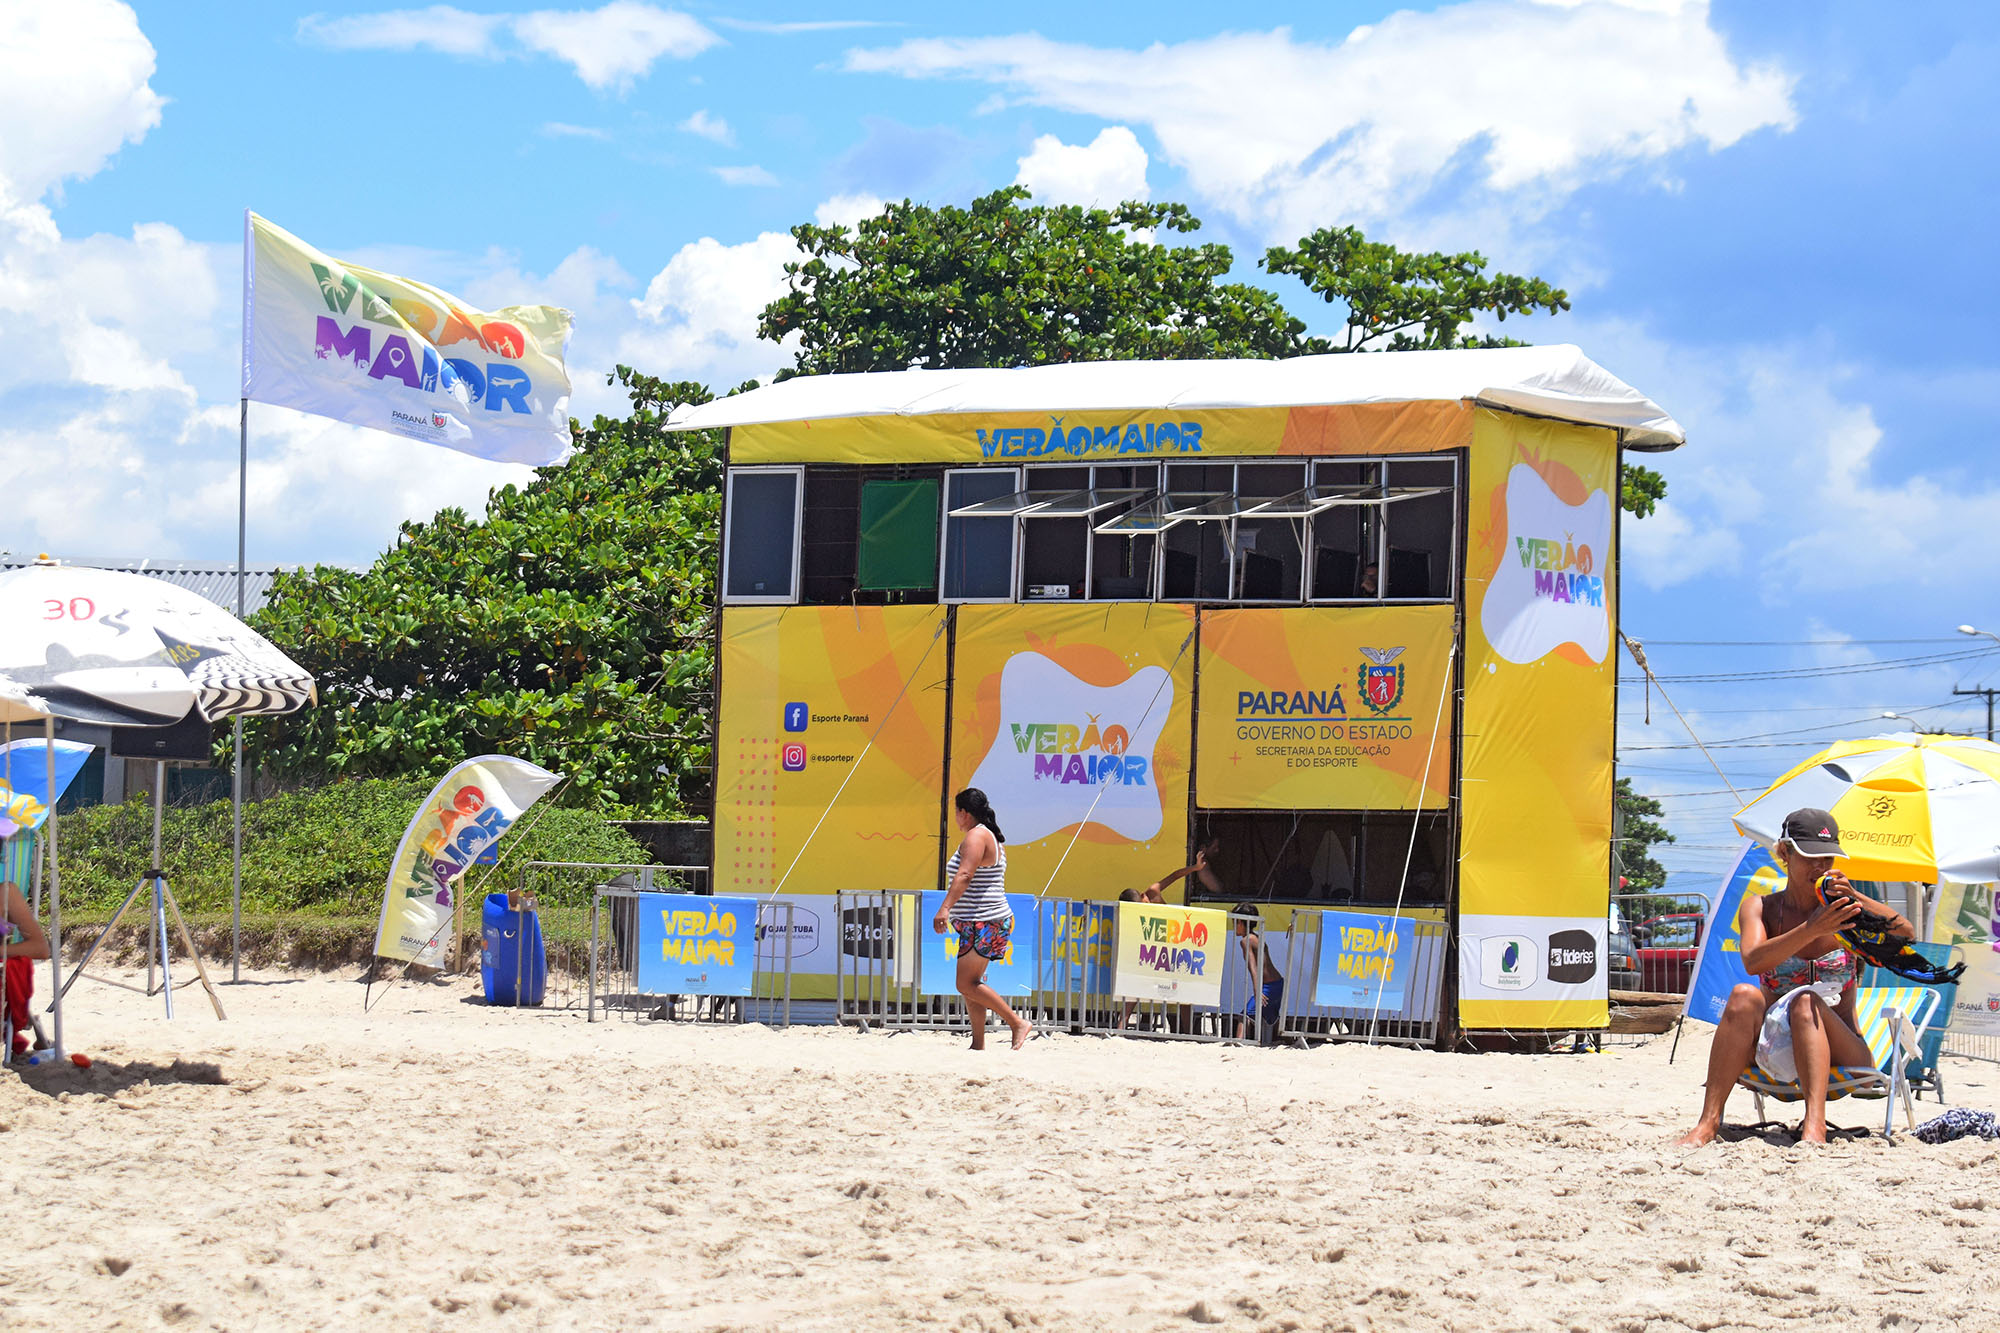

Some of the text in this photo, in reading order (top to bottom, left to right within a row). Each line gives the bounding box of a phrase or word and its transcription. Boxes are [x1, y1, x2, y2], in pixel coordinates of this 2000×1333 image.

[315, 315, 532, 414] MAIOR
[392, 411, 428, 425] PARANÁ
[1516, 529, 1593, 575] VERÃO
[1535, 569, 1602, 607] MAIOR
[43, 597, 96, 621] 30
[1238, 684, 1347, 715] PARANÁ
[811, 714, 841, 724] Esporte
[843, 714, 869, 723] Paraná
[1010, 712, 1129, 755] VERÃO
[1237, 725, 1413, 740] GOVERNO DO ESTADO
[811, 754, 854, 763] @esportepr
[1256, 744, 1391, 757] SECRETARIA DA EDUCAÇÃO
[1287, 758, 1358, 768] E DO ESPORTE
[1034, 754, 1148, 786] MAIOR
[661, 902, 737, 938] VERÃO
[1140, 912, 1208, 948] VERÃO
[1340, 920, 1399, 952] VERÃO
[662, 938, 735, 966] MAIOR
[1139, 944, 1206, 976] MAIOR
[1563, 949, 1594, 965] tiderise
[1337, 953, 1395, 982] MAIOR
